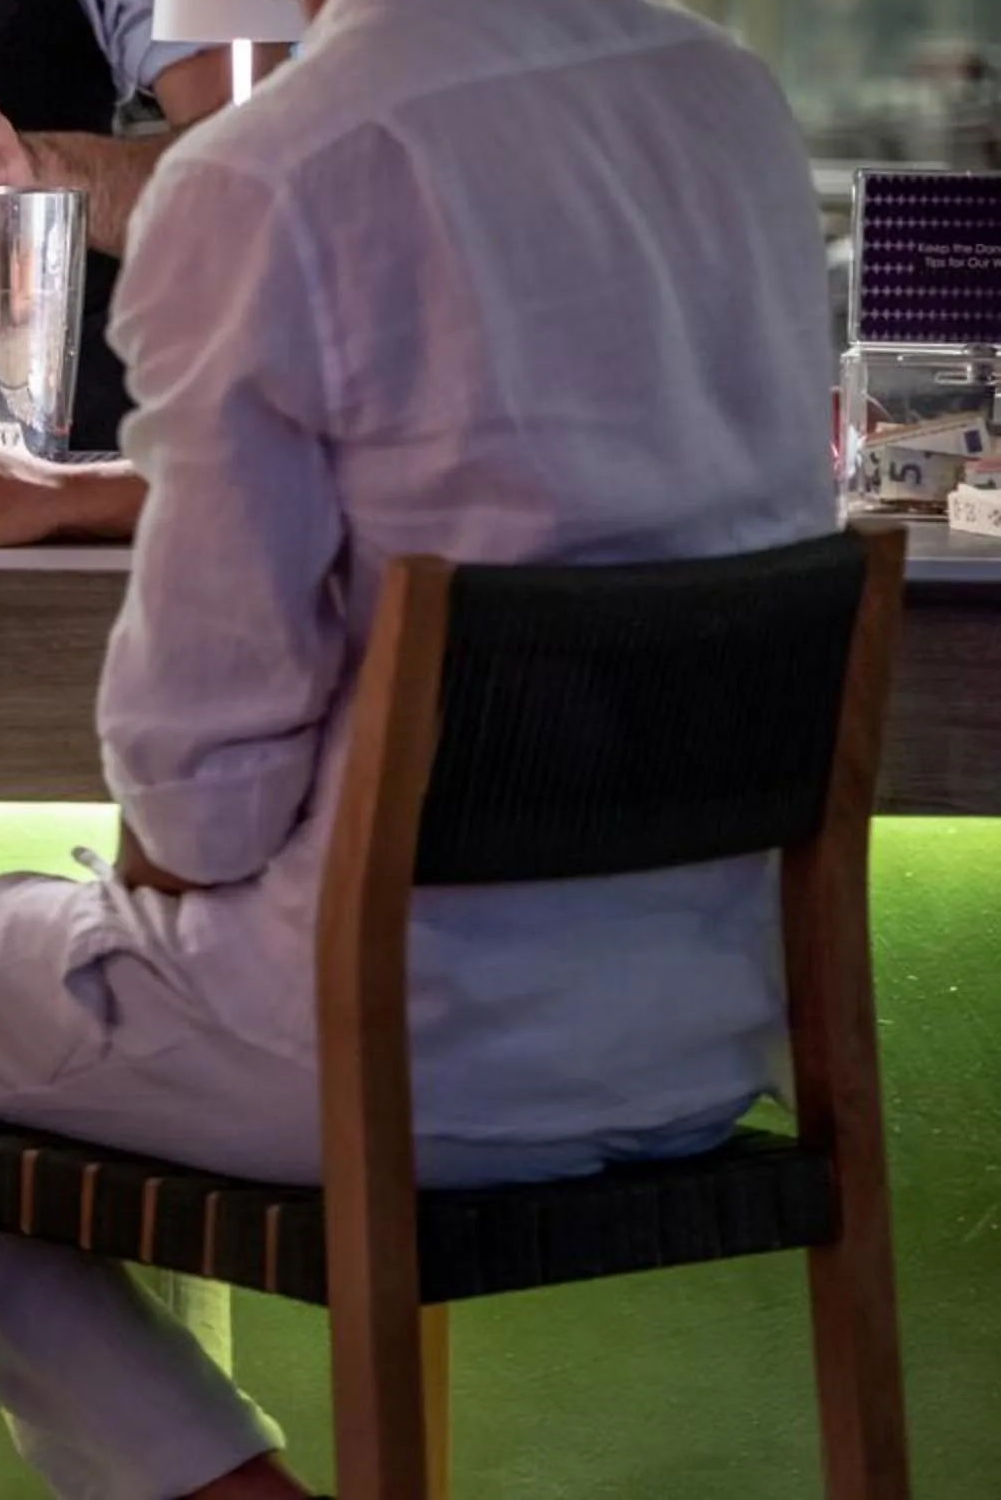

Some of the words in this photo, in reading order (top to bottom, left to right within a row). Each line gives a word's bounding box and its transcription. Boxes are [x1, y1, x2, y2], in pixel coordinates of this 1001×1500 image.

[918, 243, 950, 255] Keep
[952, 243, 973, 254] the
[925, 256, 946, 268] Tips
[948, 256, 966, 268] for
[967, 257, 990, 269] Our
